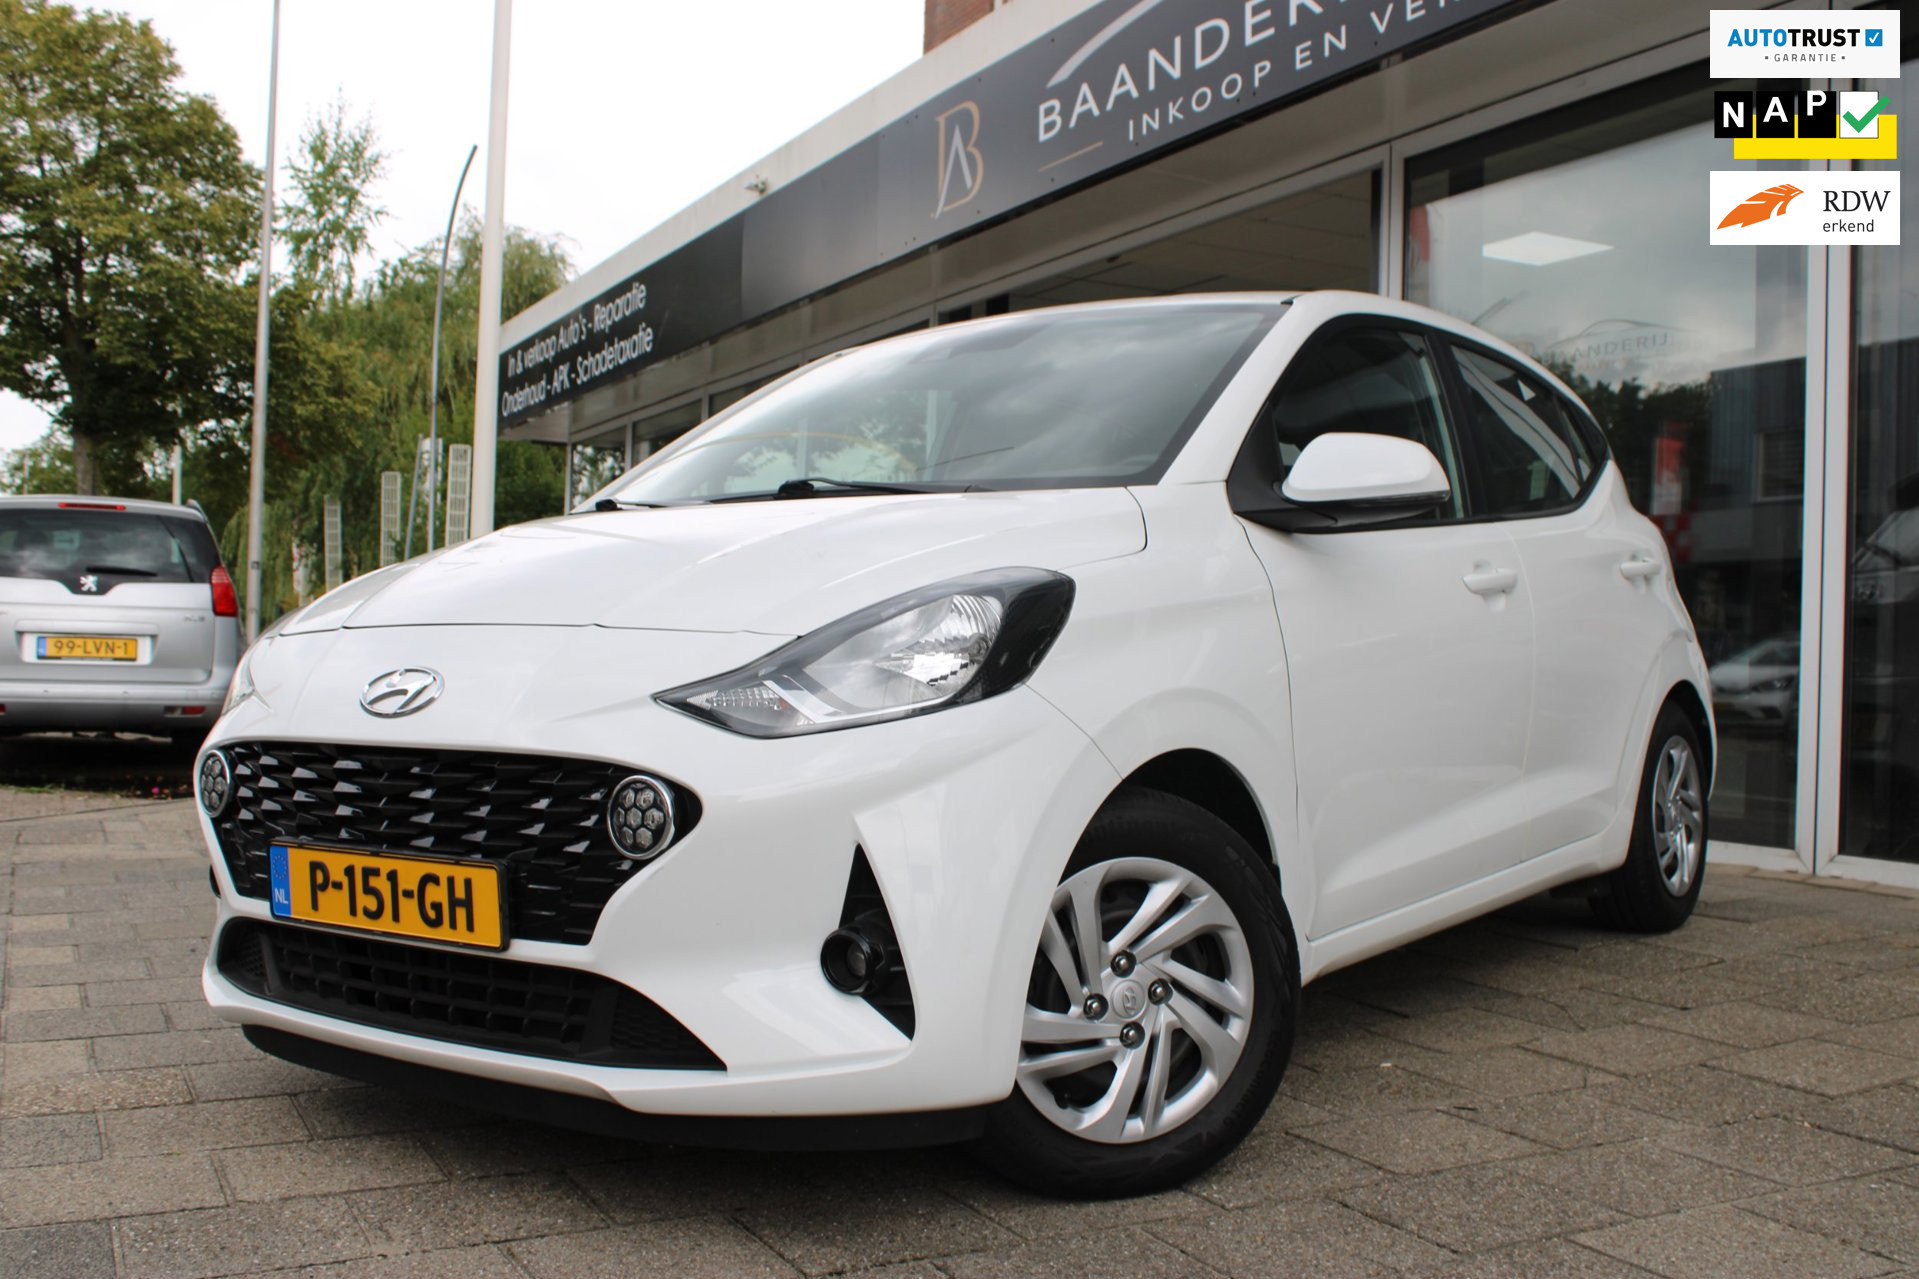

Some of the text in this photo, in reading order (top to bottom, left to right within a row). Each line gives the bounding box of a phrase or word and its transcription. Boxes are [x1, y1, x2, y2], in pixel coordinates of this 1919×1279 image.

[1129, 60, 1271, 141] INKOOP
[1295, 24, 1346, 70] EN
[502, 373, 547, 417] Onderhoud
[551, 361, 571, 396] APK
[576, 322, 653, 385] Schadetaxatie
[507, 353, 517, 378] In
[516, 349, 523, 375] &
[524, 334, 557, 368] verkoop
[558, 314, 587, 350] Auto's
[593, 281, 647, 334] Reparatie
[53, 639, 129, 656] 99-LVN-1
[274, 887, 289, 905] NL
[309, 860, 475, 933] P-151-GH
